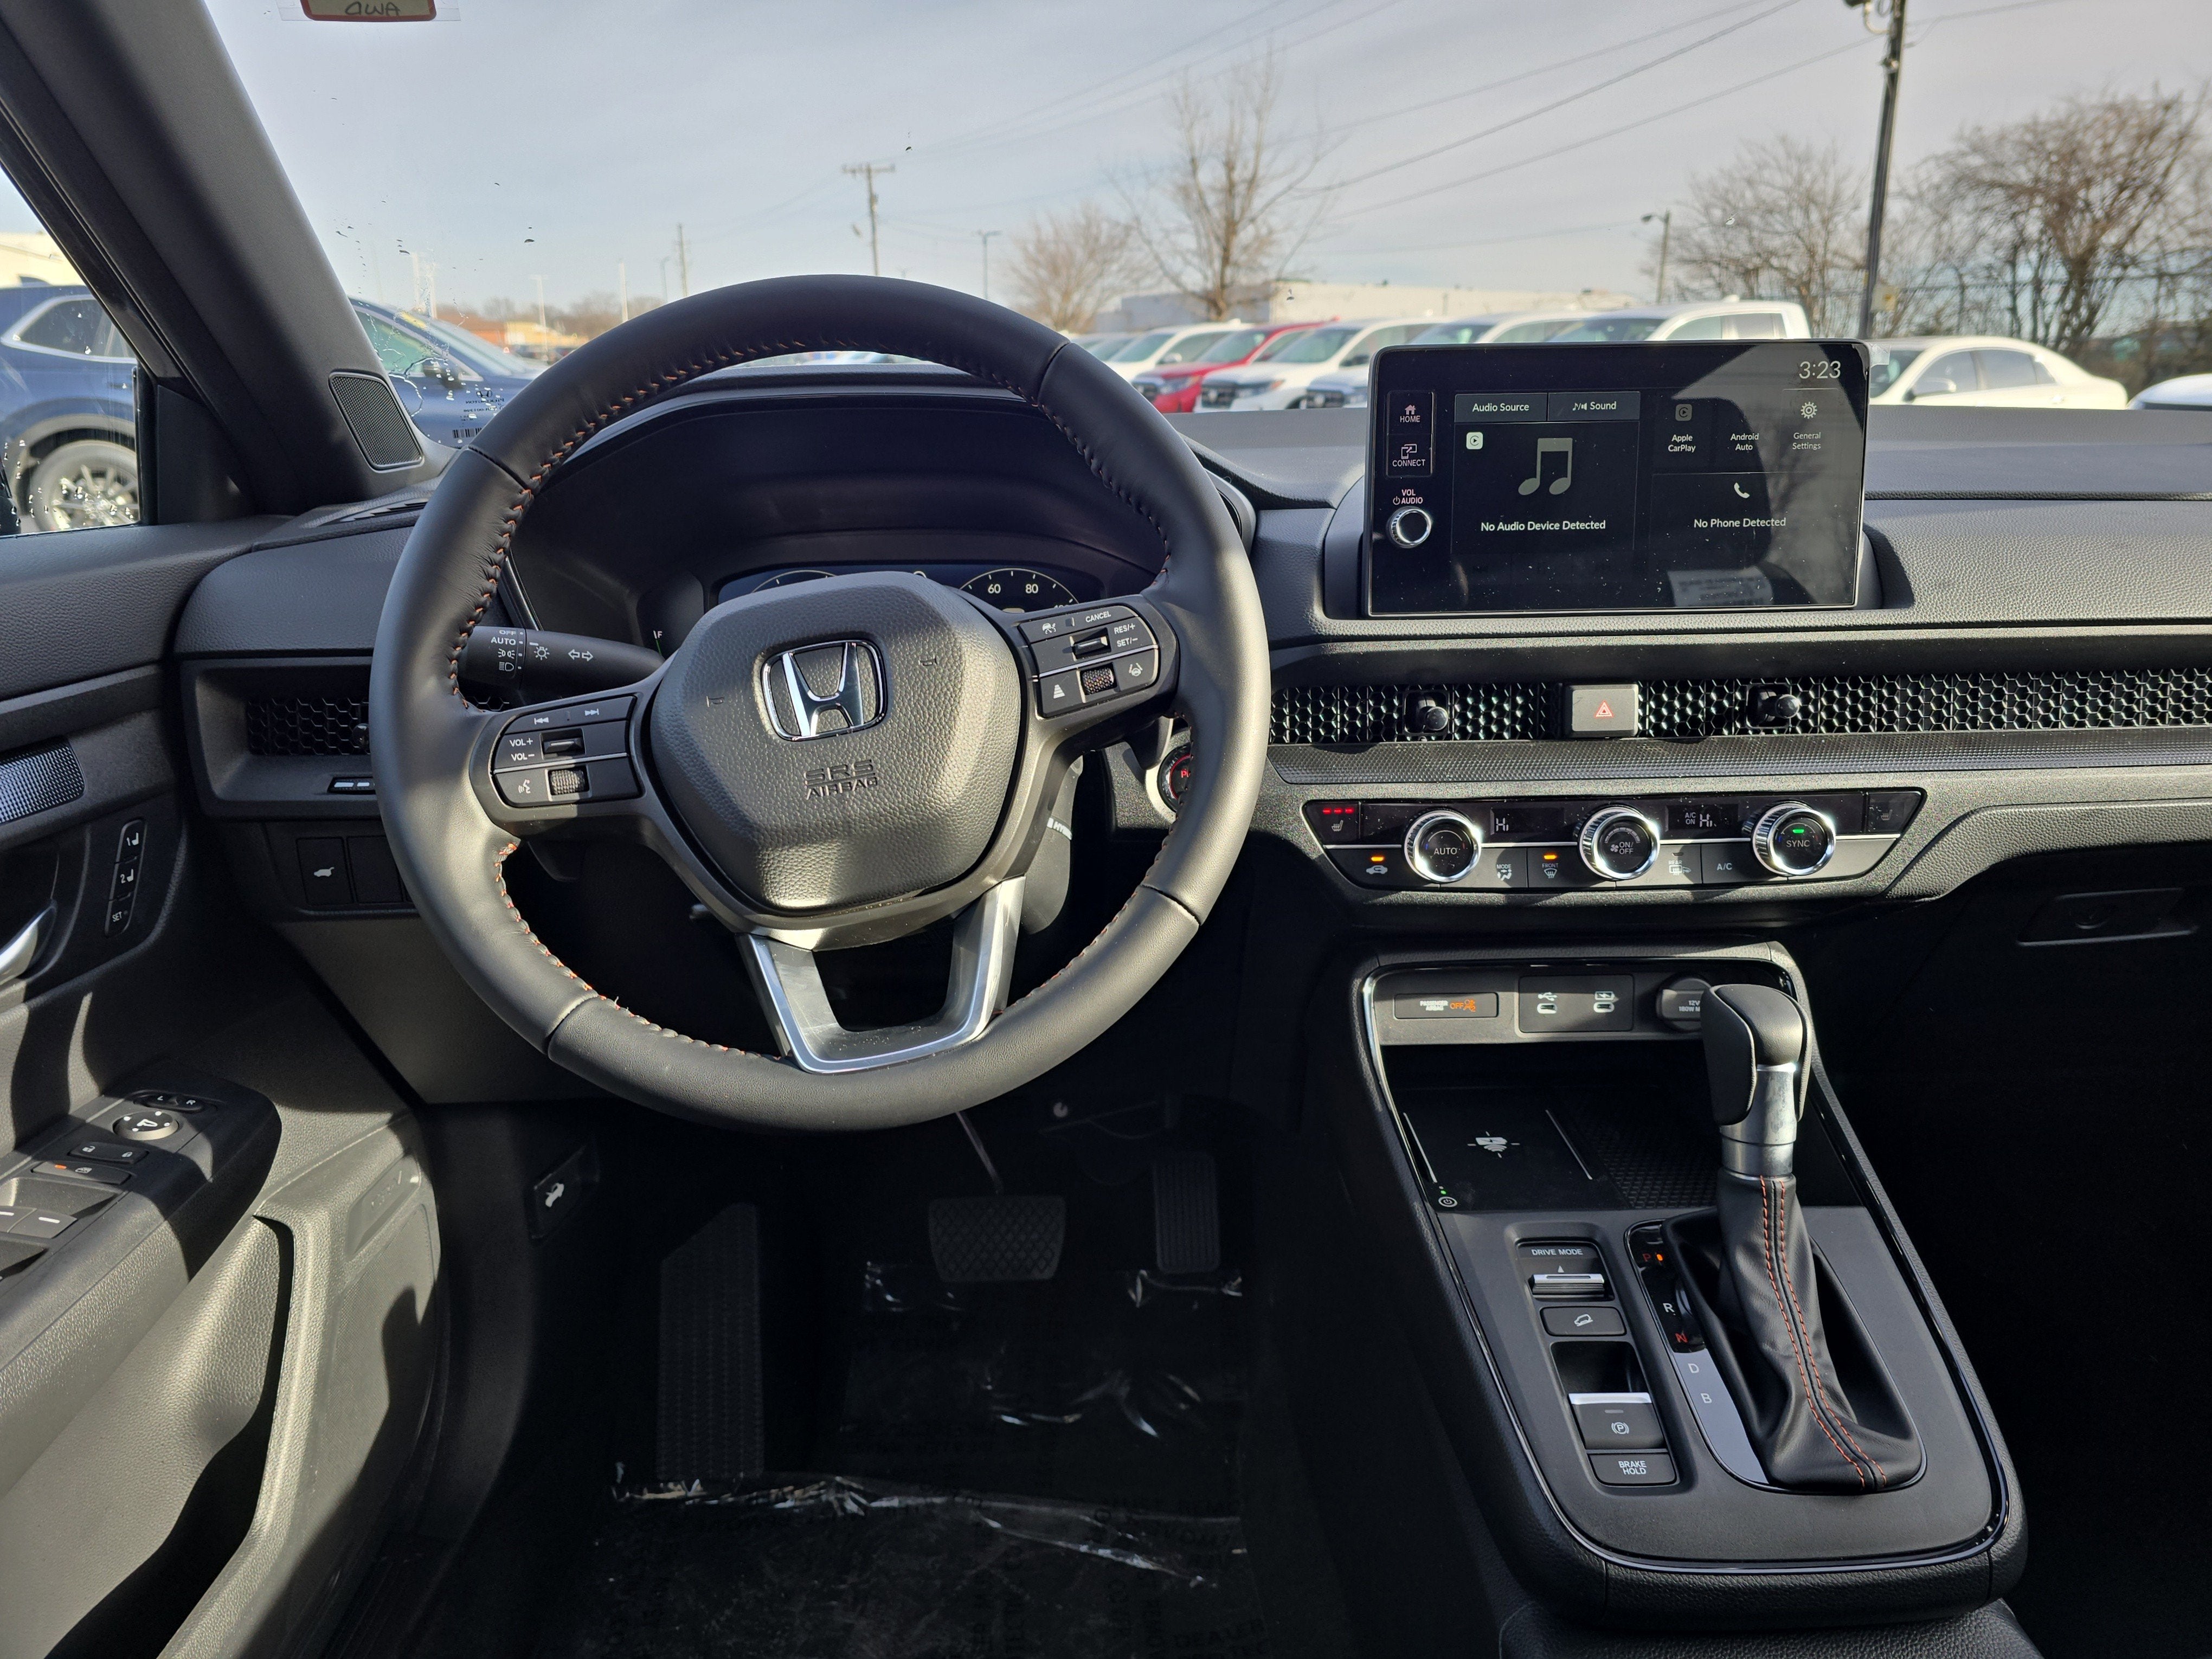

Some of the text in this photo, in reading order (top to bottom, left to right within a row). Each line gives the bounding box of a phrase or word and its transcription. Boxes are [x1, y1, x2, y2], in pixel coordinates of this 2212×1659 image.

[1799, 361, 1841, 379] 3:23
[1472, 403, 1529, 412] Audio Source
[1590, 401, 1617, 410] Sound
[1671, 434, 1693, 443] Apple
[1668, 445, 1696, 453] CarPlay
[1792, 442, 1821, 451] Settings
[1401, 497, 1423, 505] AUDIO
[1481, 519, 1606, 531] No Audio Device Detected
[1694, 517, 1786, 528] No Phone Detected
[987, 583, 1001, 594] 60
[1025, 583, 1039, 594] 80
[1085, 610, 1111, 622] CANCEL
[491, 636, 516, 645] AUTO
[803, 759, 873, 785] SRS
[805, 776, 878, 800] AIRBAG
[1786, 840, 1811, 848] SYNC
[1716, 863, 1733, 871] A/C
[112, 911, 123, 922] SET
[1642, 1253, 1652, 1262] P
[1663, 1302, 1674, 1314] R
[1675, 1333, 1687, 1343] N
[1688, 1363, 1700, 1374] D
[1700, 1393, 1712, 1404] B
[1618, 1461, 1647, 1469] BRAKE
